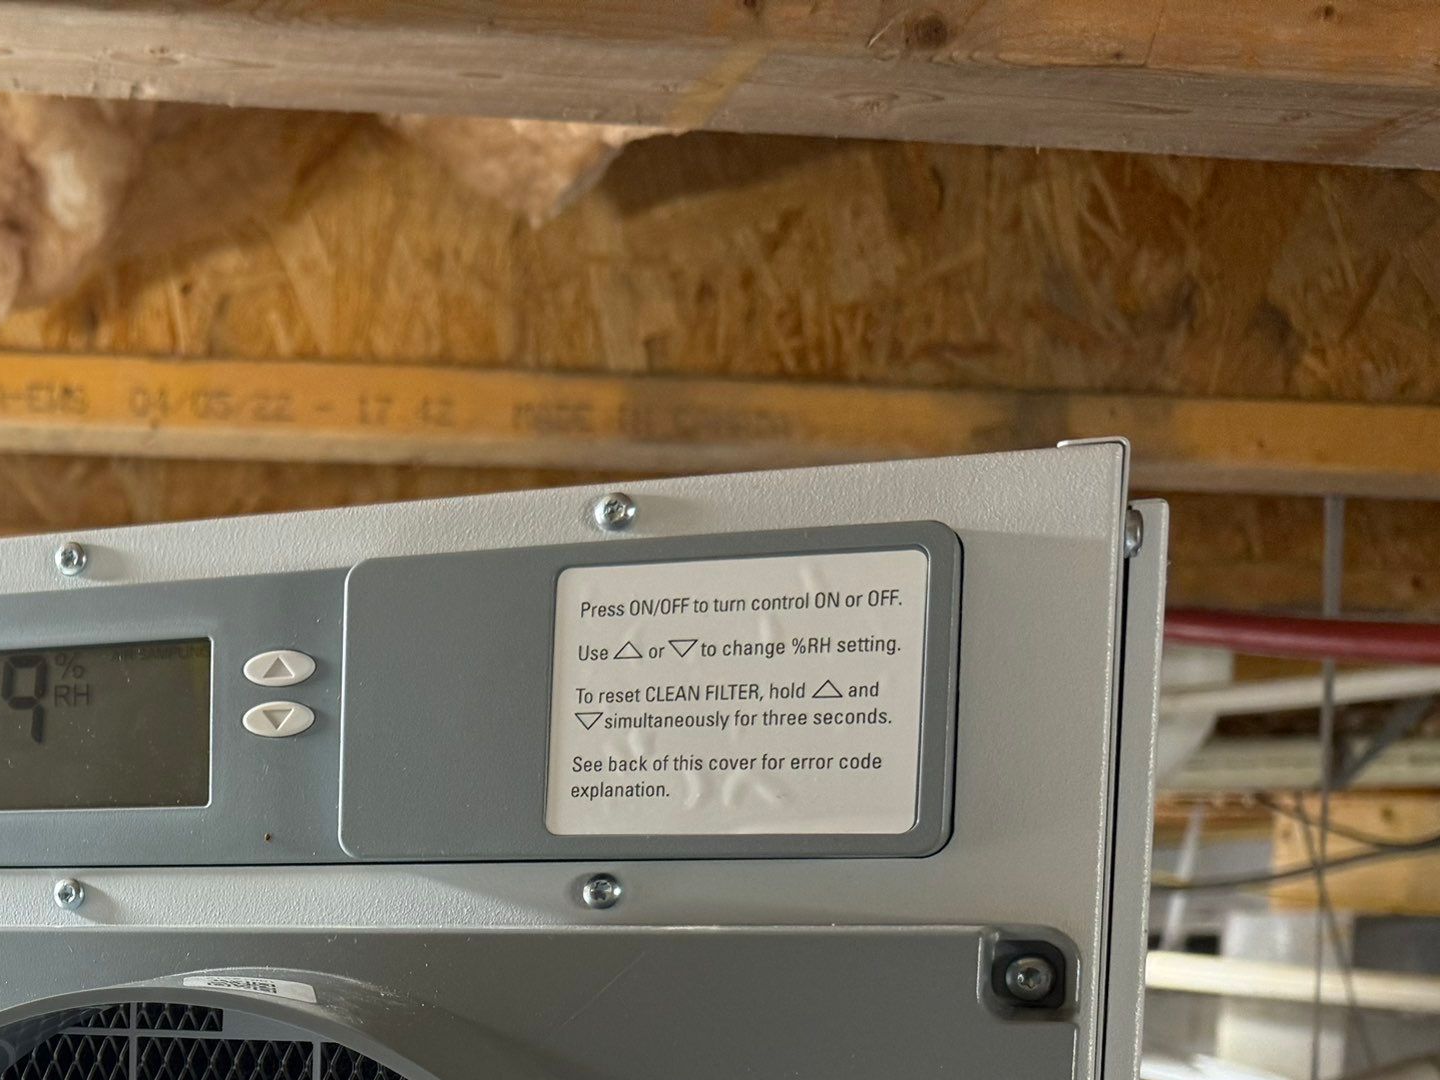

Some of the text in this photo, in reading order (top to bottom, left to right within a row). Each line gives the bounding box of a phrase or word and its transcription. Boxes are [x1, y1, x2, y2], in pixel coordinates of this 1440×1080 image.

[581, 589, 902, 617] Press ON/OFF to turn control ON or OFF.
[579, 635, 900, 661] Use or to change %RH setting.
[54, 653, 86, 681] %
[53, 683, 91, 708] RH
[576, 682, 879, 704] To reset CLEAN FILTER, hold and
[605, 708, 891, 730] simultaneously for three seconds.
[573, 753, 881, 772] See back of this cover for error code
[571, 781, 669, 801] explanation.
